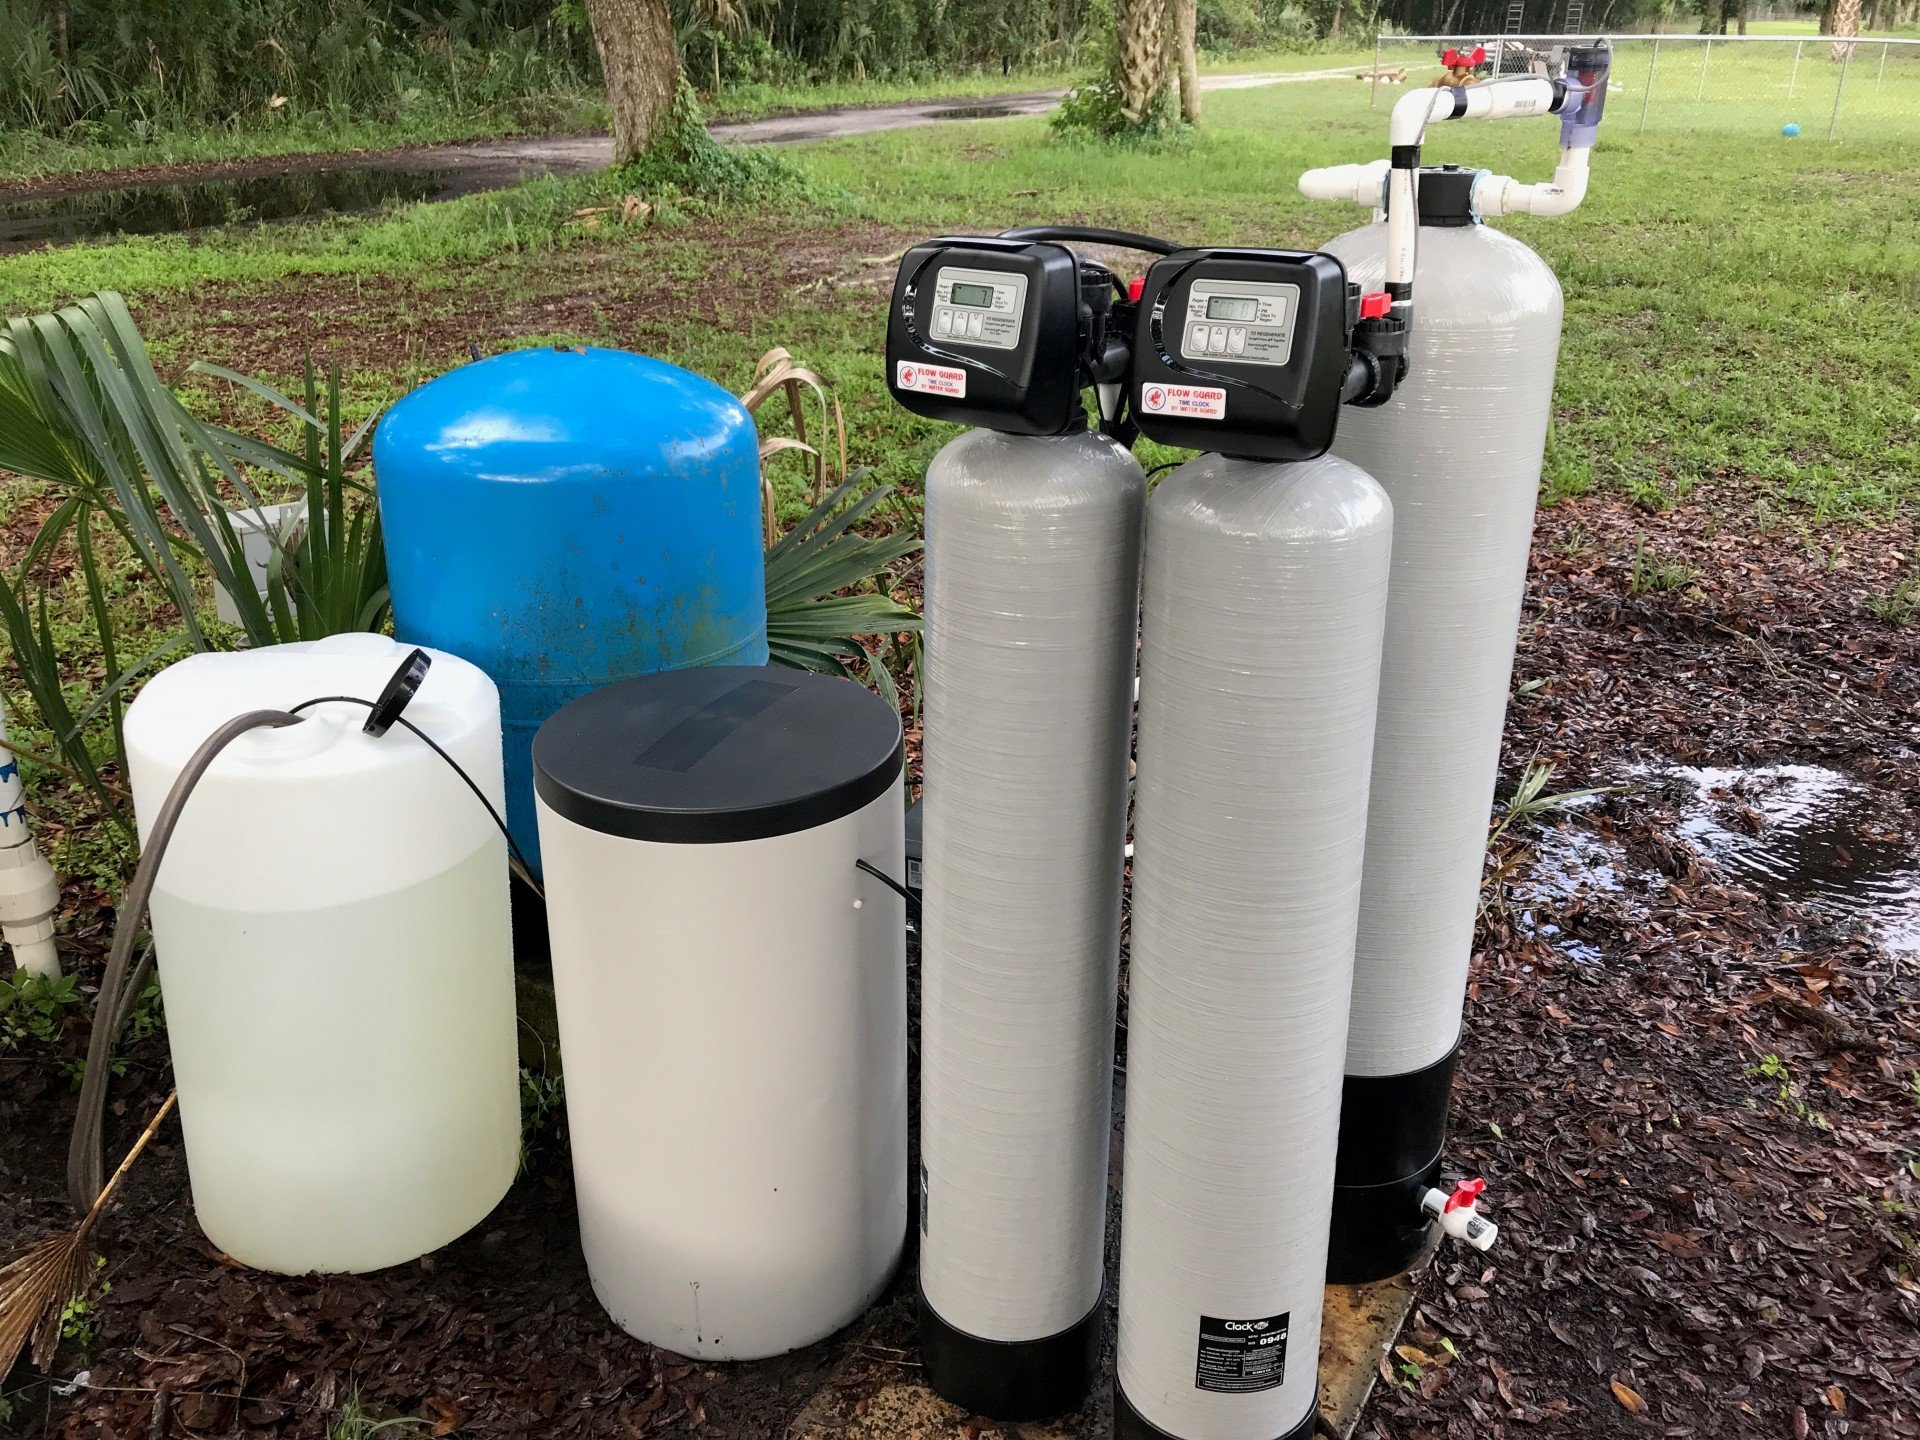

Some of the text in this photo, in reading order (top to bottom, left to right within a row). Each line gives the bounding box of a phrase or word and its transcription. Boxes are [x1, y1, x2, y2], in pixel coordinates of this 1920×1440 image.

[918, 367, 964, 381] FLOW GUARD
[927, 378, 954, 388] TIME CLOCK
[1167, 388, 1223, 401] FLOW GUARD
[1192, 400, 1210, 408] CLOCK
[1224, 1322, 1254, 1332] Clack
[1259, 1331, 1287, 1346] 0948
